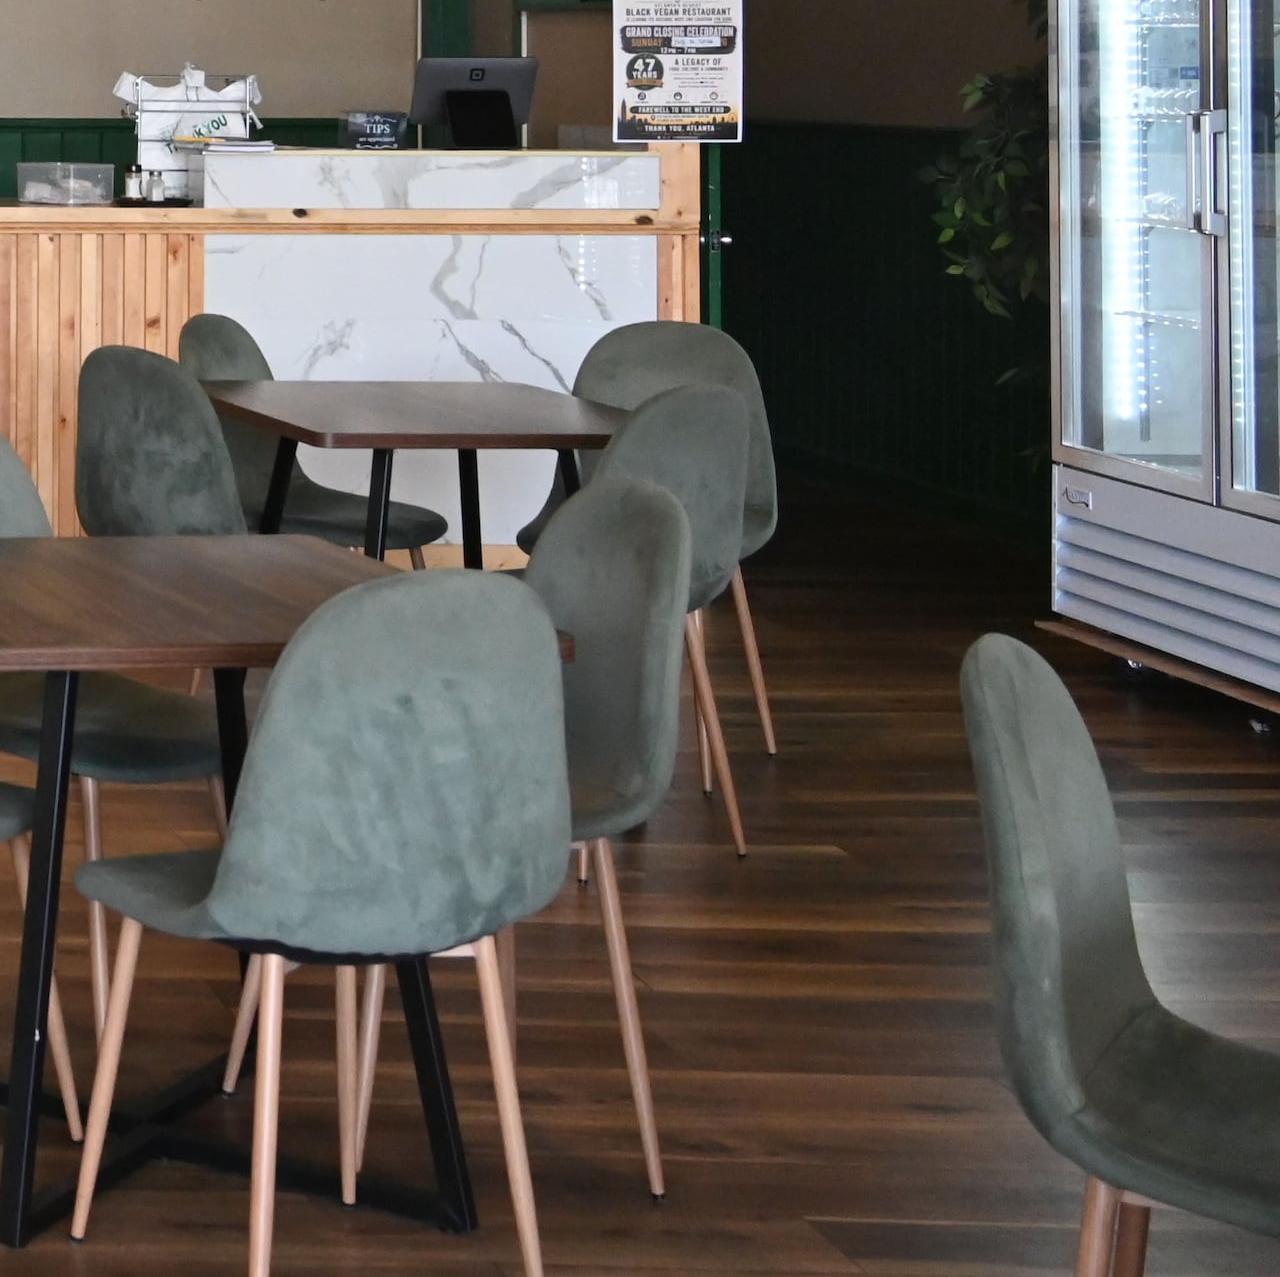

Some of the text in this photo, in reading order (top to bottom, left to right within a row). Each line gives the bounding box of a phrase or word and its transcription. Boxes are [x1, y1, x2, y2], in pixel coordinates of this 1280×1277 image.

[626, 8, 732, 16] BLACK VEGAN RESTAURANT
[626, 26, 734, 38] GRAND CLOSING CELEBRATION
[631, 38, 664, 47] SUNDAY
[633, 58, 656, 72] 47
[632, 71, 658, 79] YEARS
[205, 114, 228, 134] YOU
[364, 123, 391, 134] TIPS
